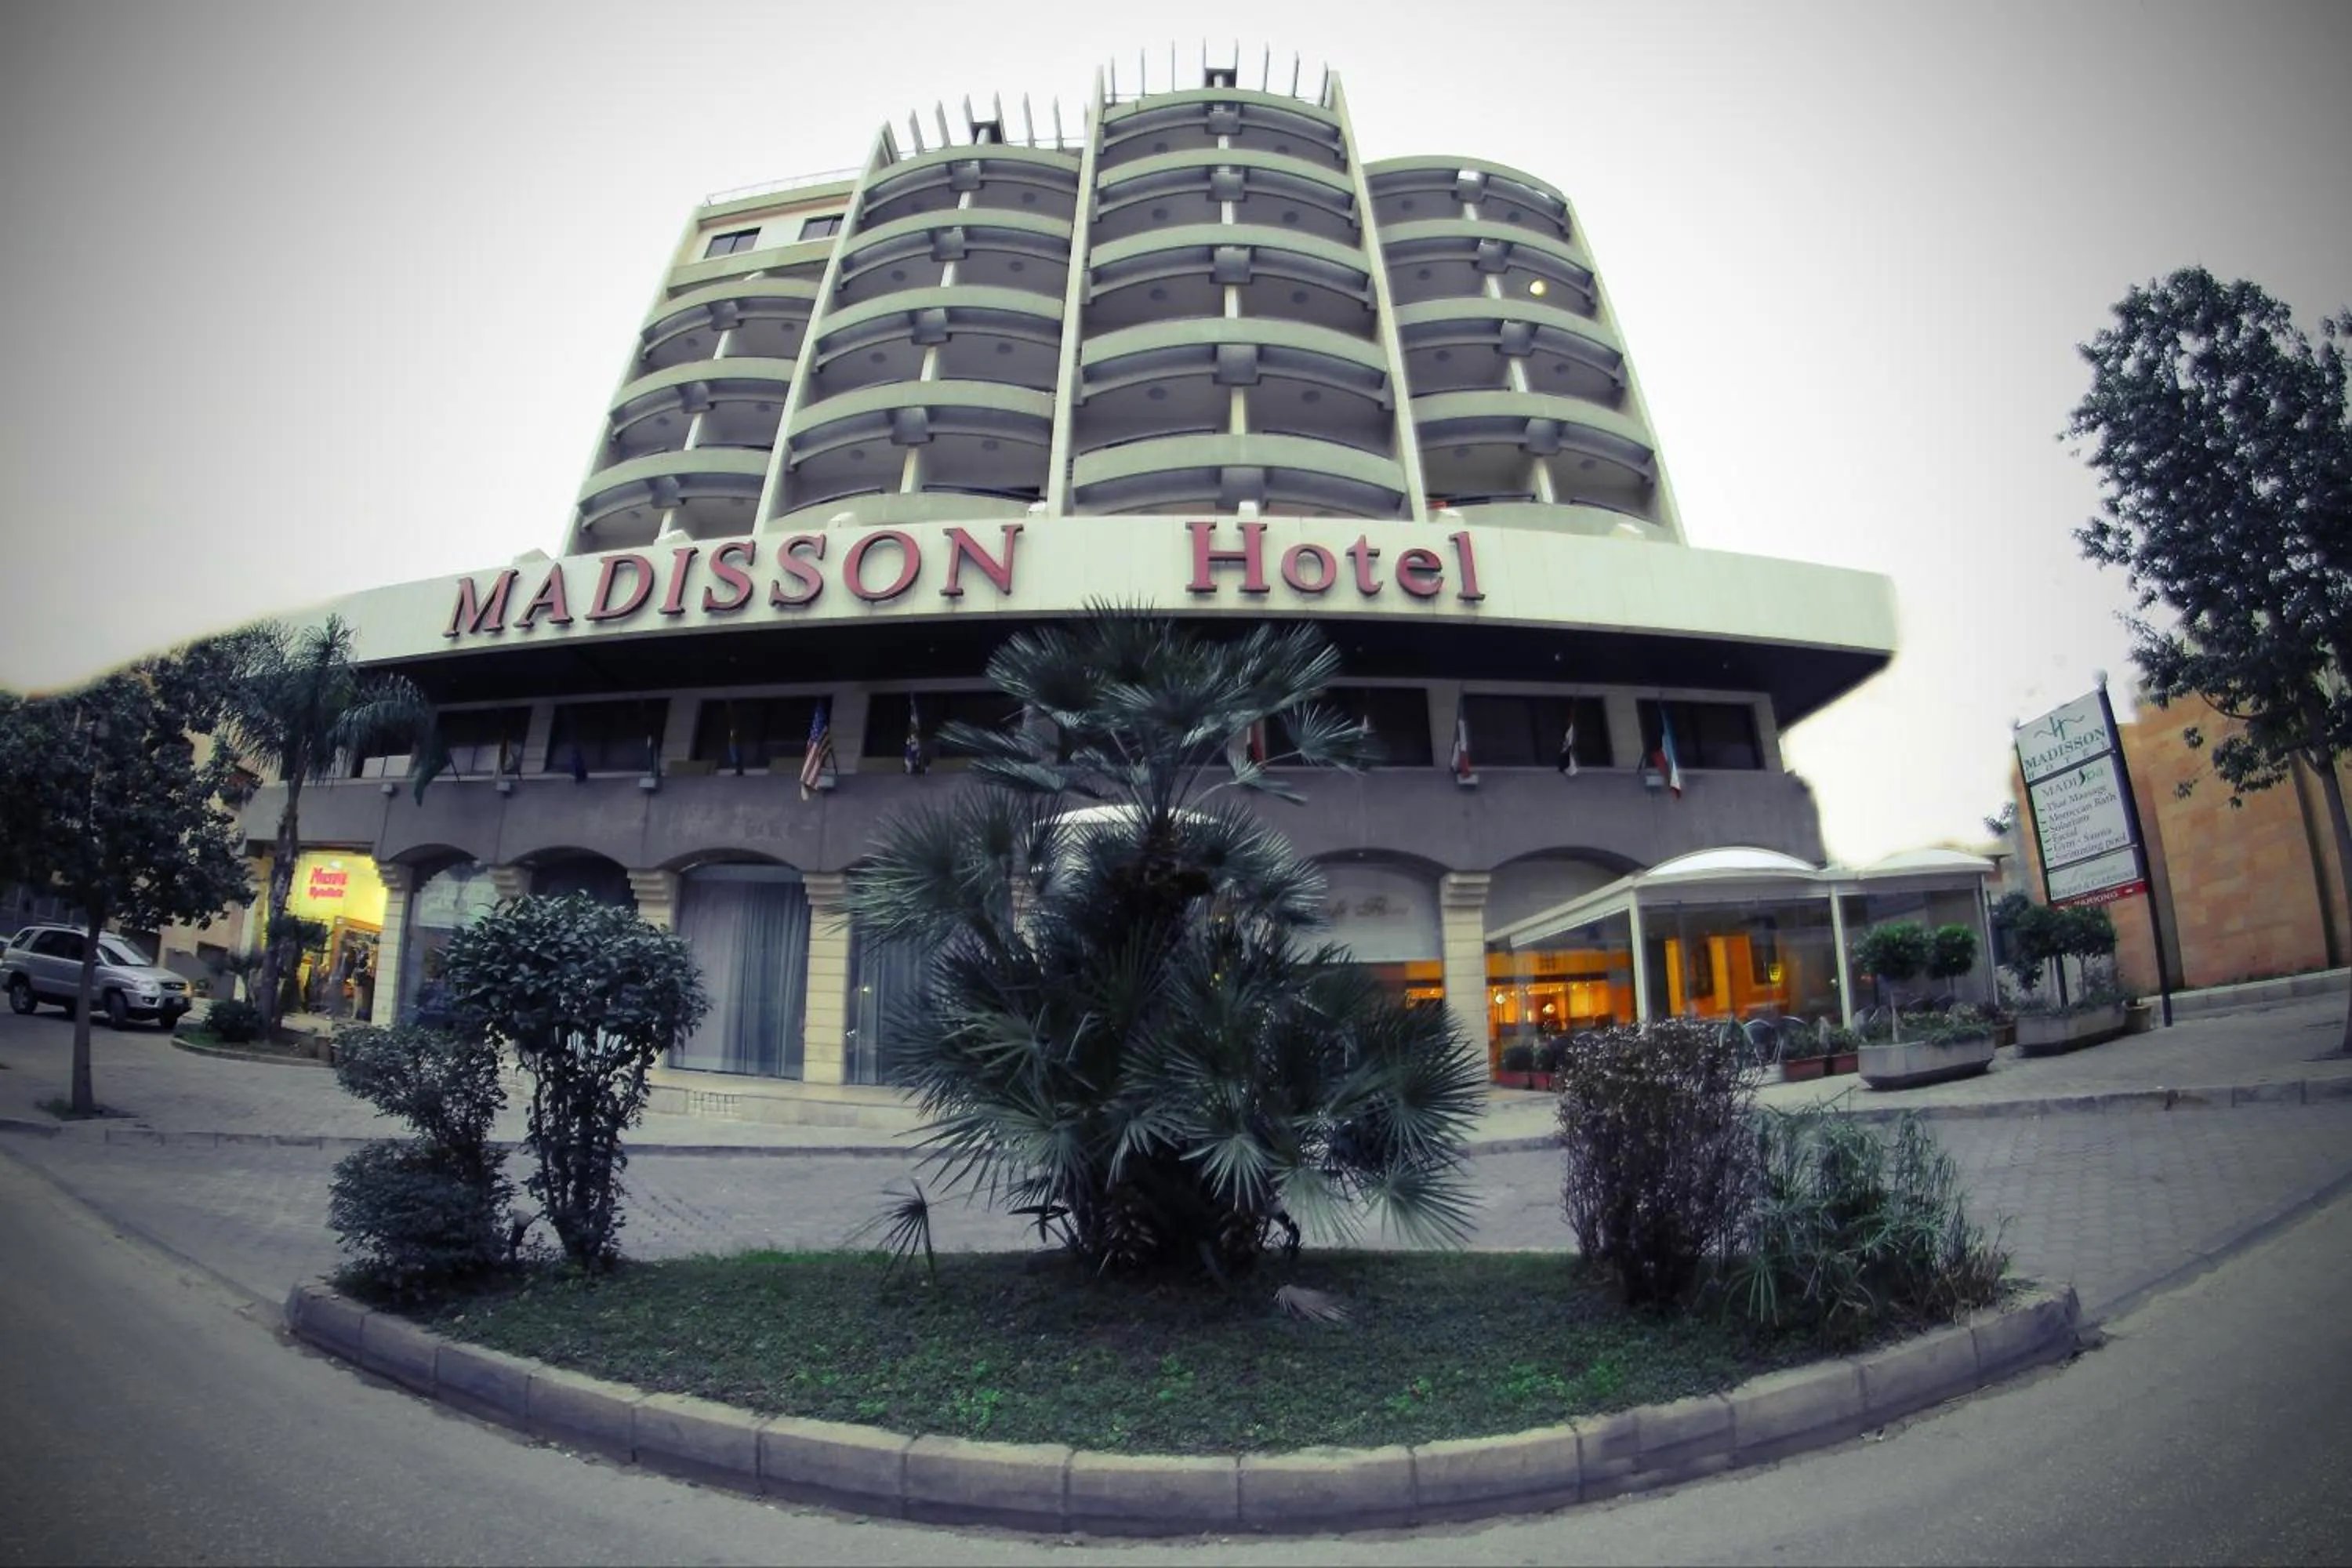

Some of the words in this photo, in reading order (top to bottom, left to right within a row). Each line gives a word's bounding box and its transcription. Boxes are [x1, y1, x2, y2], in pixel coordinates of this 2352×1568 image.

[442, 523, 1024, 638] MADISSON
[1185, 521, 1486, 601] Hotel
[2024, 726, 2107, 771] MADISSON
[2027, 741, 2110, 779] HOTEL
[2049, 804, 2092, 822] Moroccan
[2094, 793, 2117, 807] Bath
